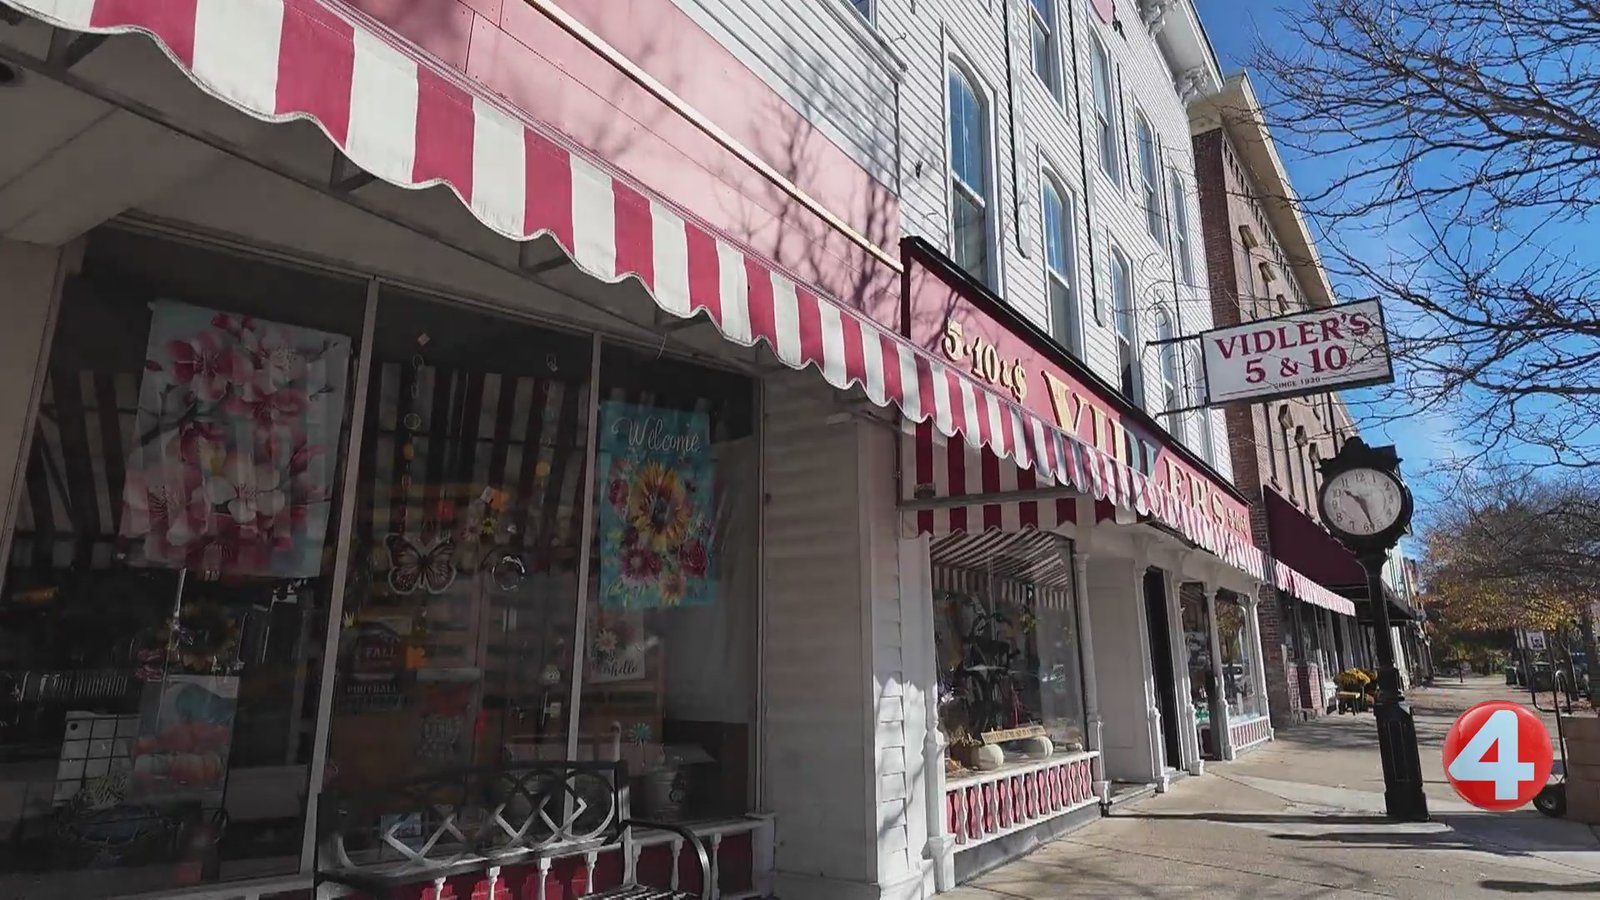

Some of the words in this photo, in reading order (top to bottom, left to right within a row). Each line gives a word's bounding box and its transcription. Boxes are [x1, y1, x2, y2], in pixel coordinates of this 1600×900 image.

[1214, 312, 1371, 360] VIDLER'S
[1245, 358, 1266, 383] 5
[1279, 357, 1299, 377] &
[1308, 344, 1348, 373] 10
[1273, 380, 1296, 389] SINCE
[611, 414, 700, 453] Welcome
[365, 647, 397, 658] FALL
